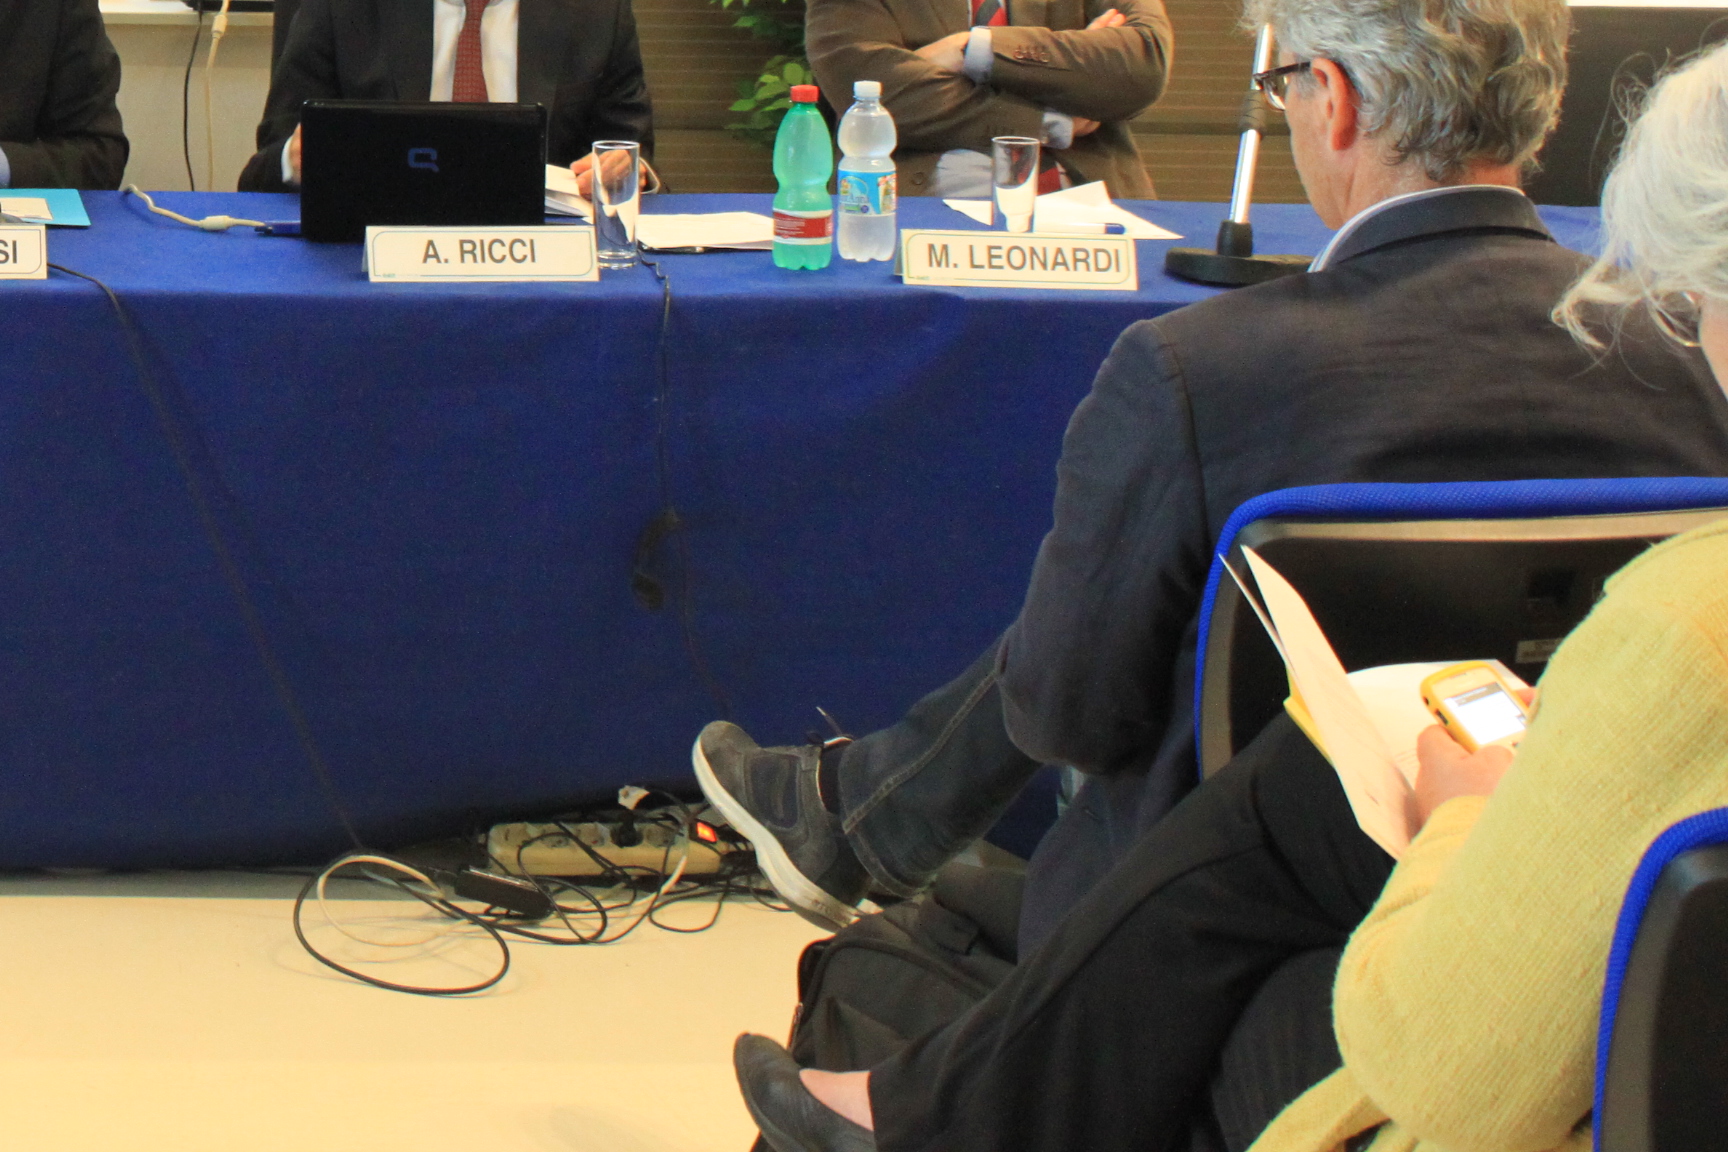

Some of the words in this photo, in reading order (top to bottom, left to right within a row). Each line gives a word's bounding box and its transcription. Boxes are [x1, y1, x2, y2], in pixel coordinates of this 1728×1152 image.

[422, 239, 449, 264] A.
[458, 238, 536, 264] RICCI
[927, 243, 958, 269] M.
[968, 244, 1120, 273] LEONARDI
